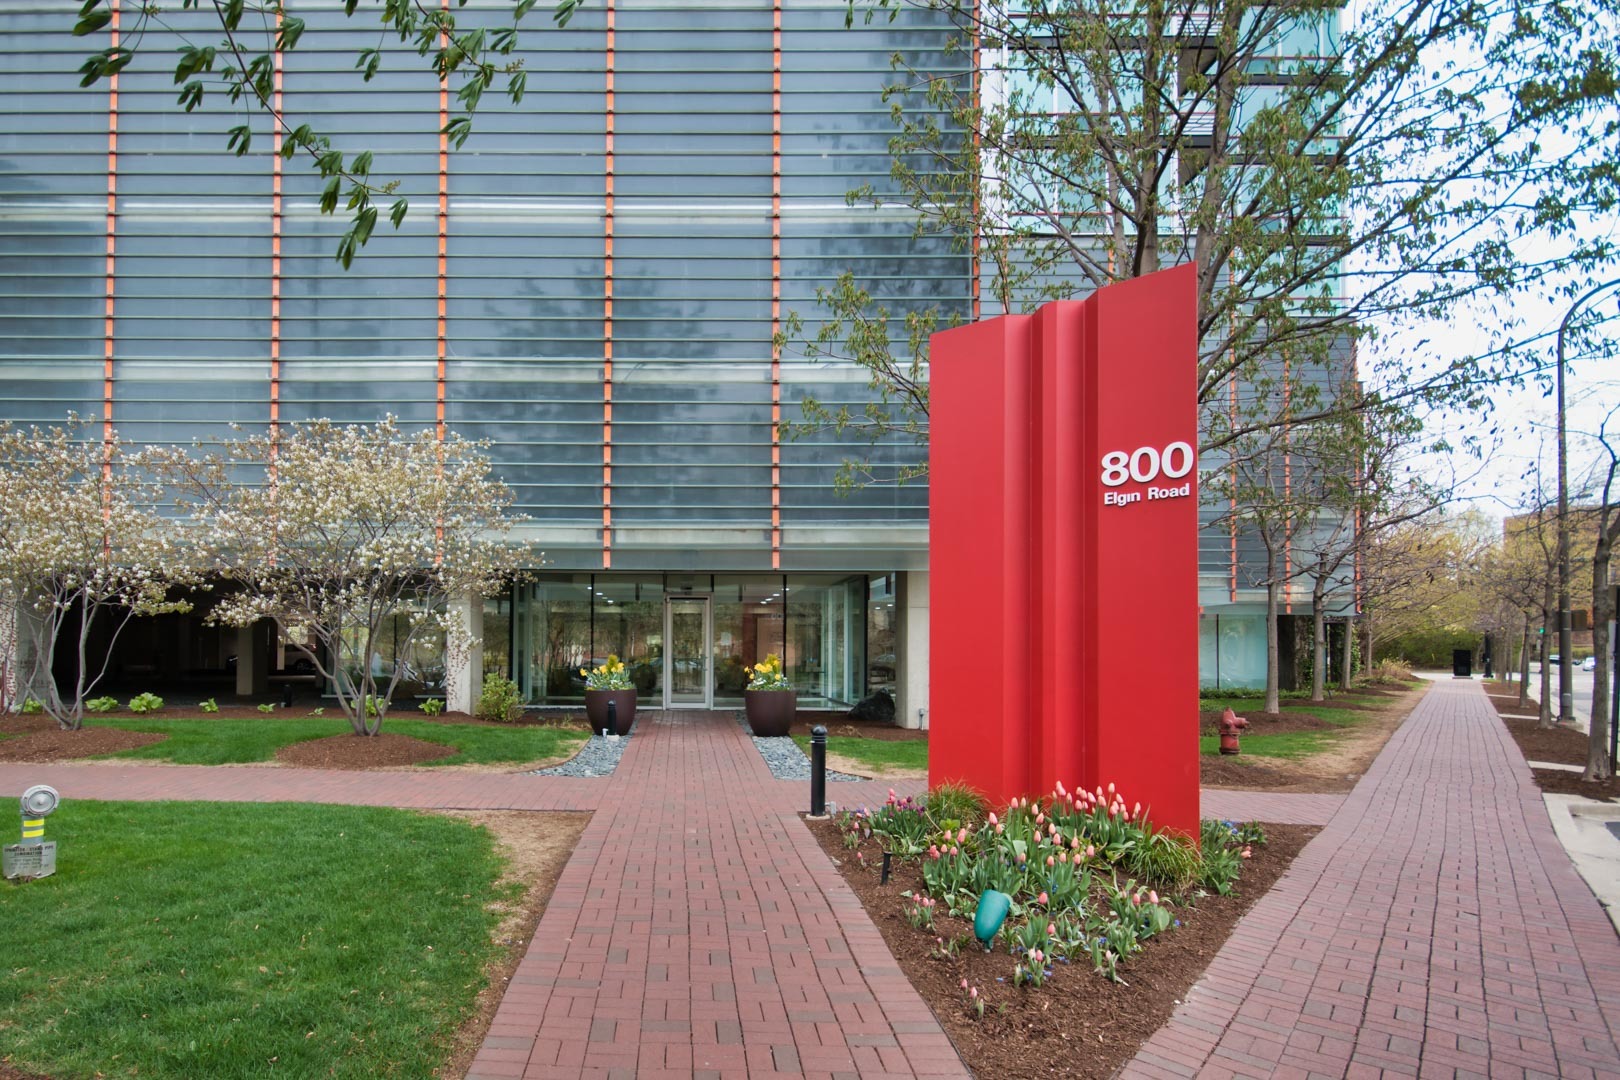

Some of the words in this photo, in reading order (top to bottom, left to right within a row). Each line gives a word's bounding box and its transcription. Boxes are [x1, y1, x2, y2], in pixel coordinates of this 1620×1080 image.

[1101, 441, 1194, 486] 800
[1104, 491, 1141, 506] Elgin
[1147, 483, 1190, 500] Road
